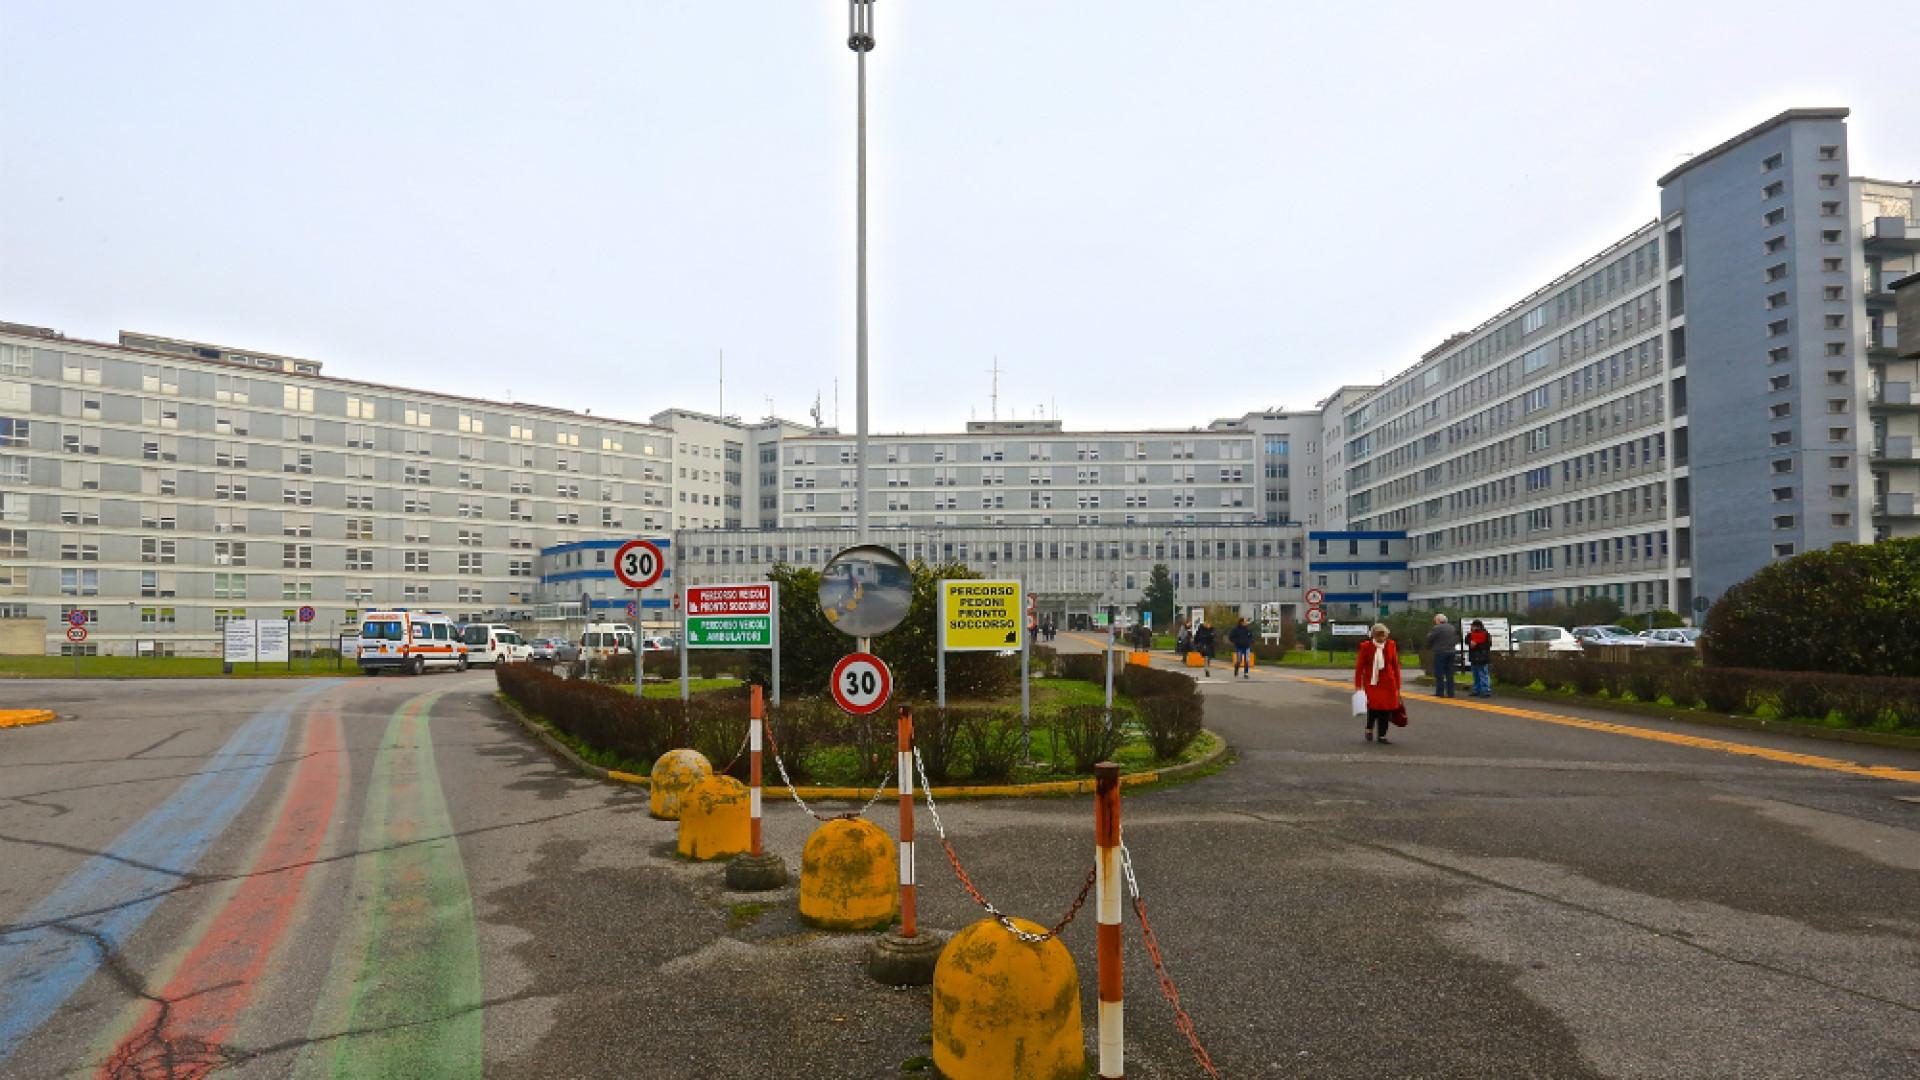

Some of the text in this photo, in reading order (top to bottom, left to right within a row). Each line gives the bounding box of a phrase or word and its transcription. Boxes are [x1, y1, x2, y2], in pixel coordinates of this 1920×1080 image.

[626, 554, 653, 576] 30
[701, 589, 766, 600] PERCORSO VEICOLI
[950, 587, 1014, 595] PERCORSO
[701, 600, 768, 612] PRONTO SOCCORSO
[960, 598, 1004, 606] PEDONI
[958, 609, 1006, 618] PRONTO
[701, 620, 766, 630] PERCORSO VEICOLI
[950, 620, 1014, 629] SOCCORSO
[706, 631, 761, 641] AMBULATORI
[846, 671, 876, 695] 30
